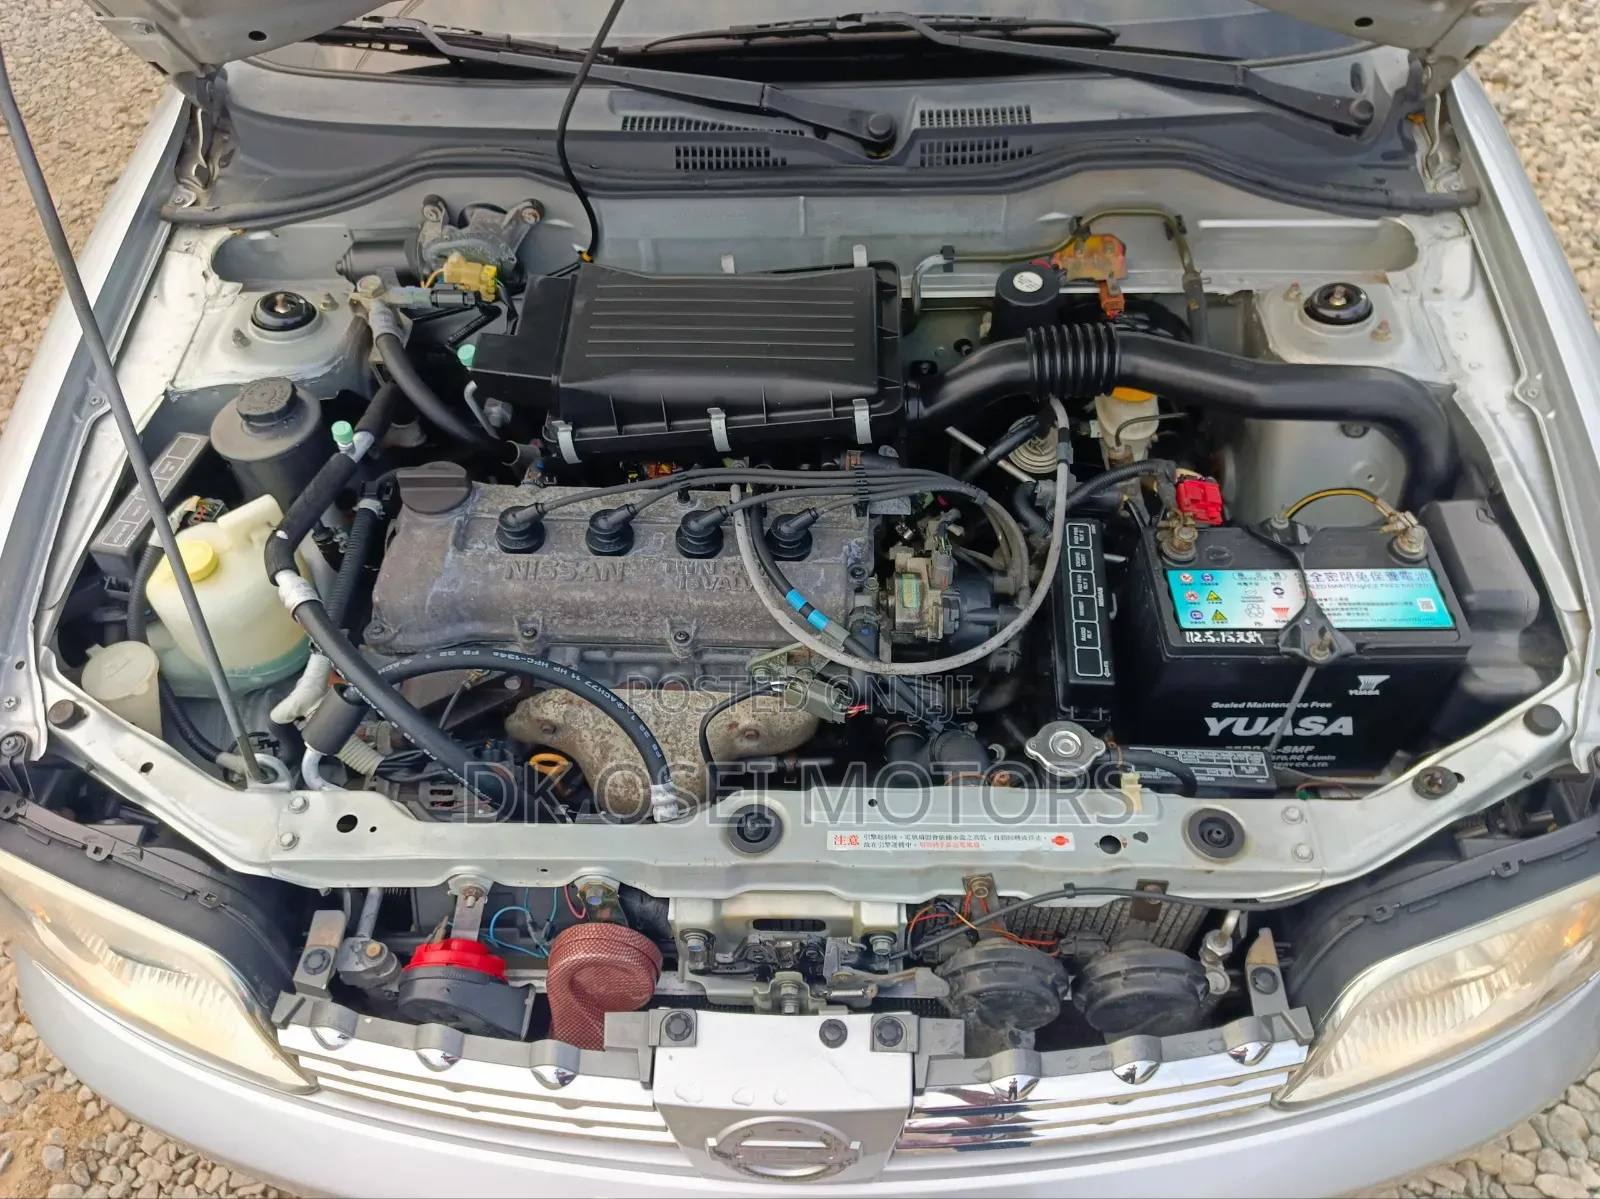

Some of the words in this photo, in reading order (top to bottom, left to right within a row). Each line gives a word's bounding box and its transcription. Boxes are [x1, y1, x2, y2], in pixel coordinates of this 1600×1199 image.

[503, 560, 625, 582] NISSAN
[1211, 702, 1246, 710] Sealed
[1310, 702, 1332, 710] Free
[1204, 716, 1354, 737] YUASA
[834, 834, 860, 846] 注意
